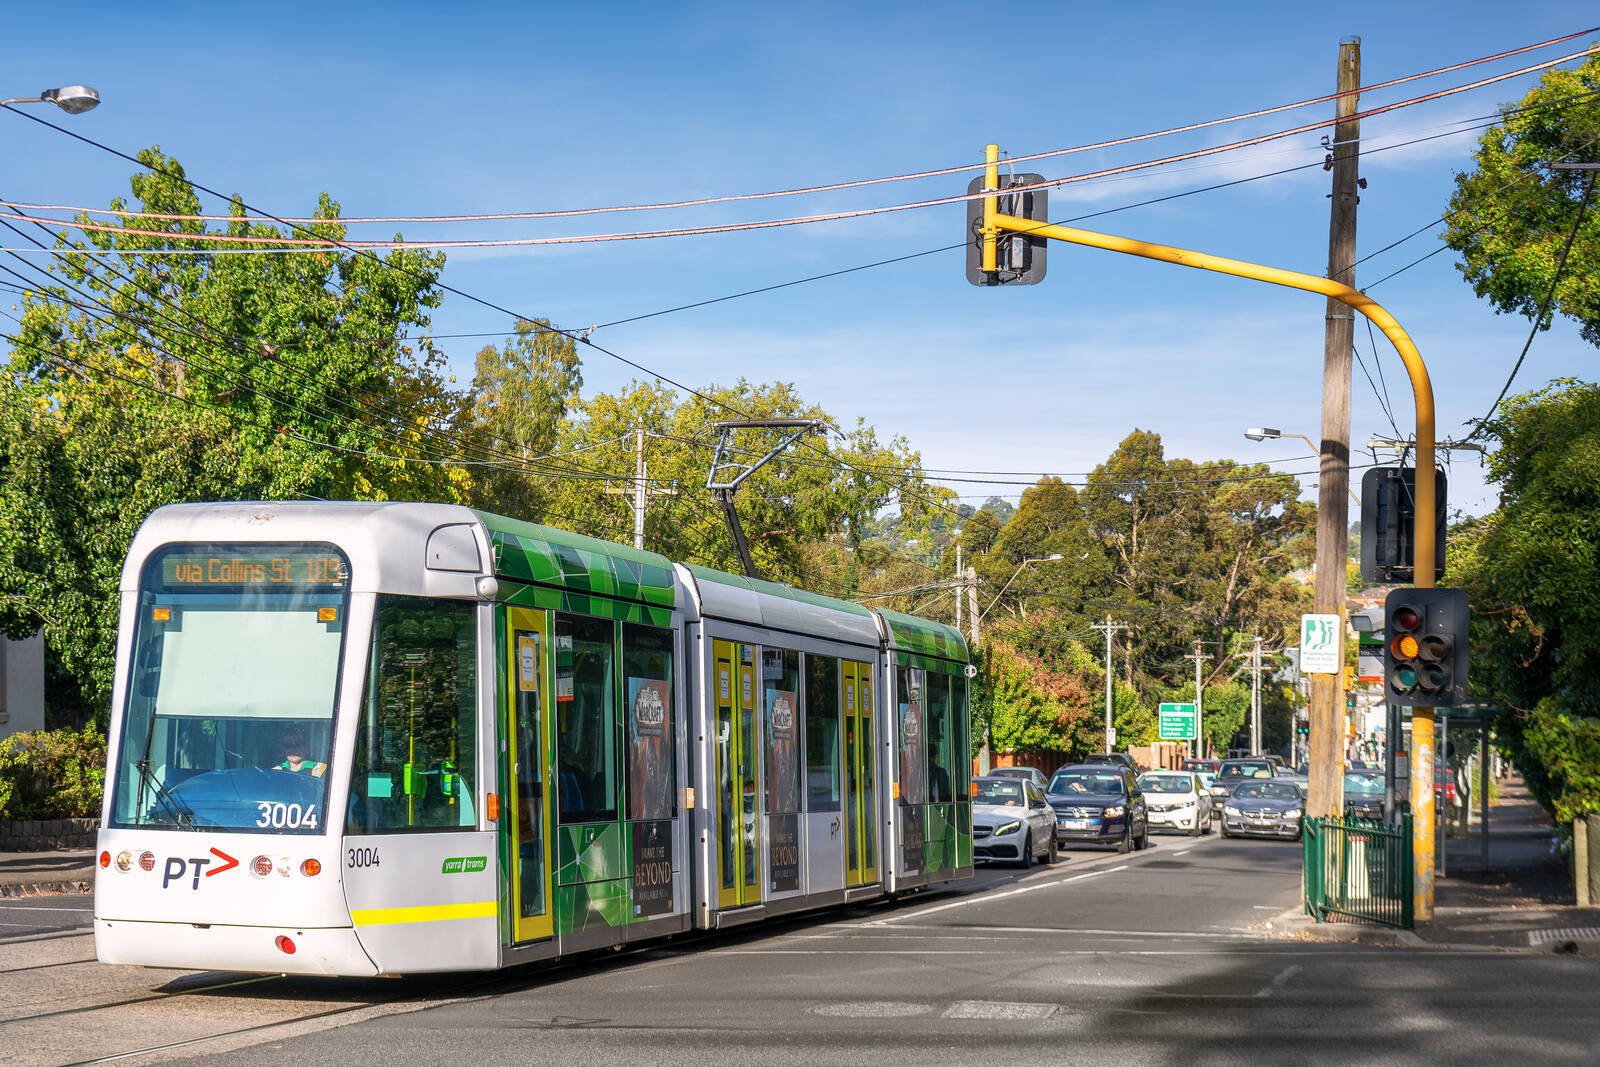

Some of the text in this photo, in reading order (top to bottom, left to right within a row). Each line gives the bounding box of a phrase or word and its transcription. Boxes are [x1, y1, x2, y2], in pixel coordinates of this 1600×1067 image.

[175, 558, 203, 583] via
[208, 557, 266, 583] Collins
[270, 557, 295, 583] St
[256, 802, 318, 829] 3004
[347, 847, 380, 868] 3004
[445, 859, 484, 872] yarra trams
[771, 846, 798, 866] BEYOND
[636, 861, 671, 887] BEYOND
